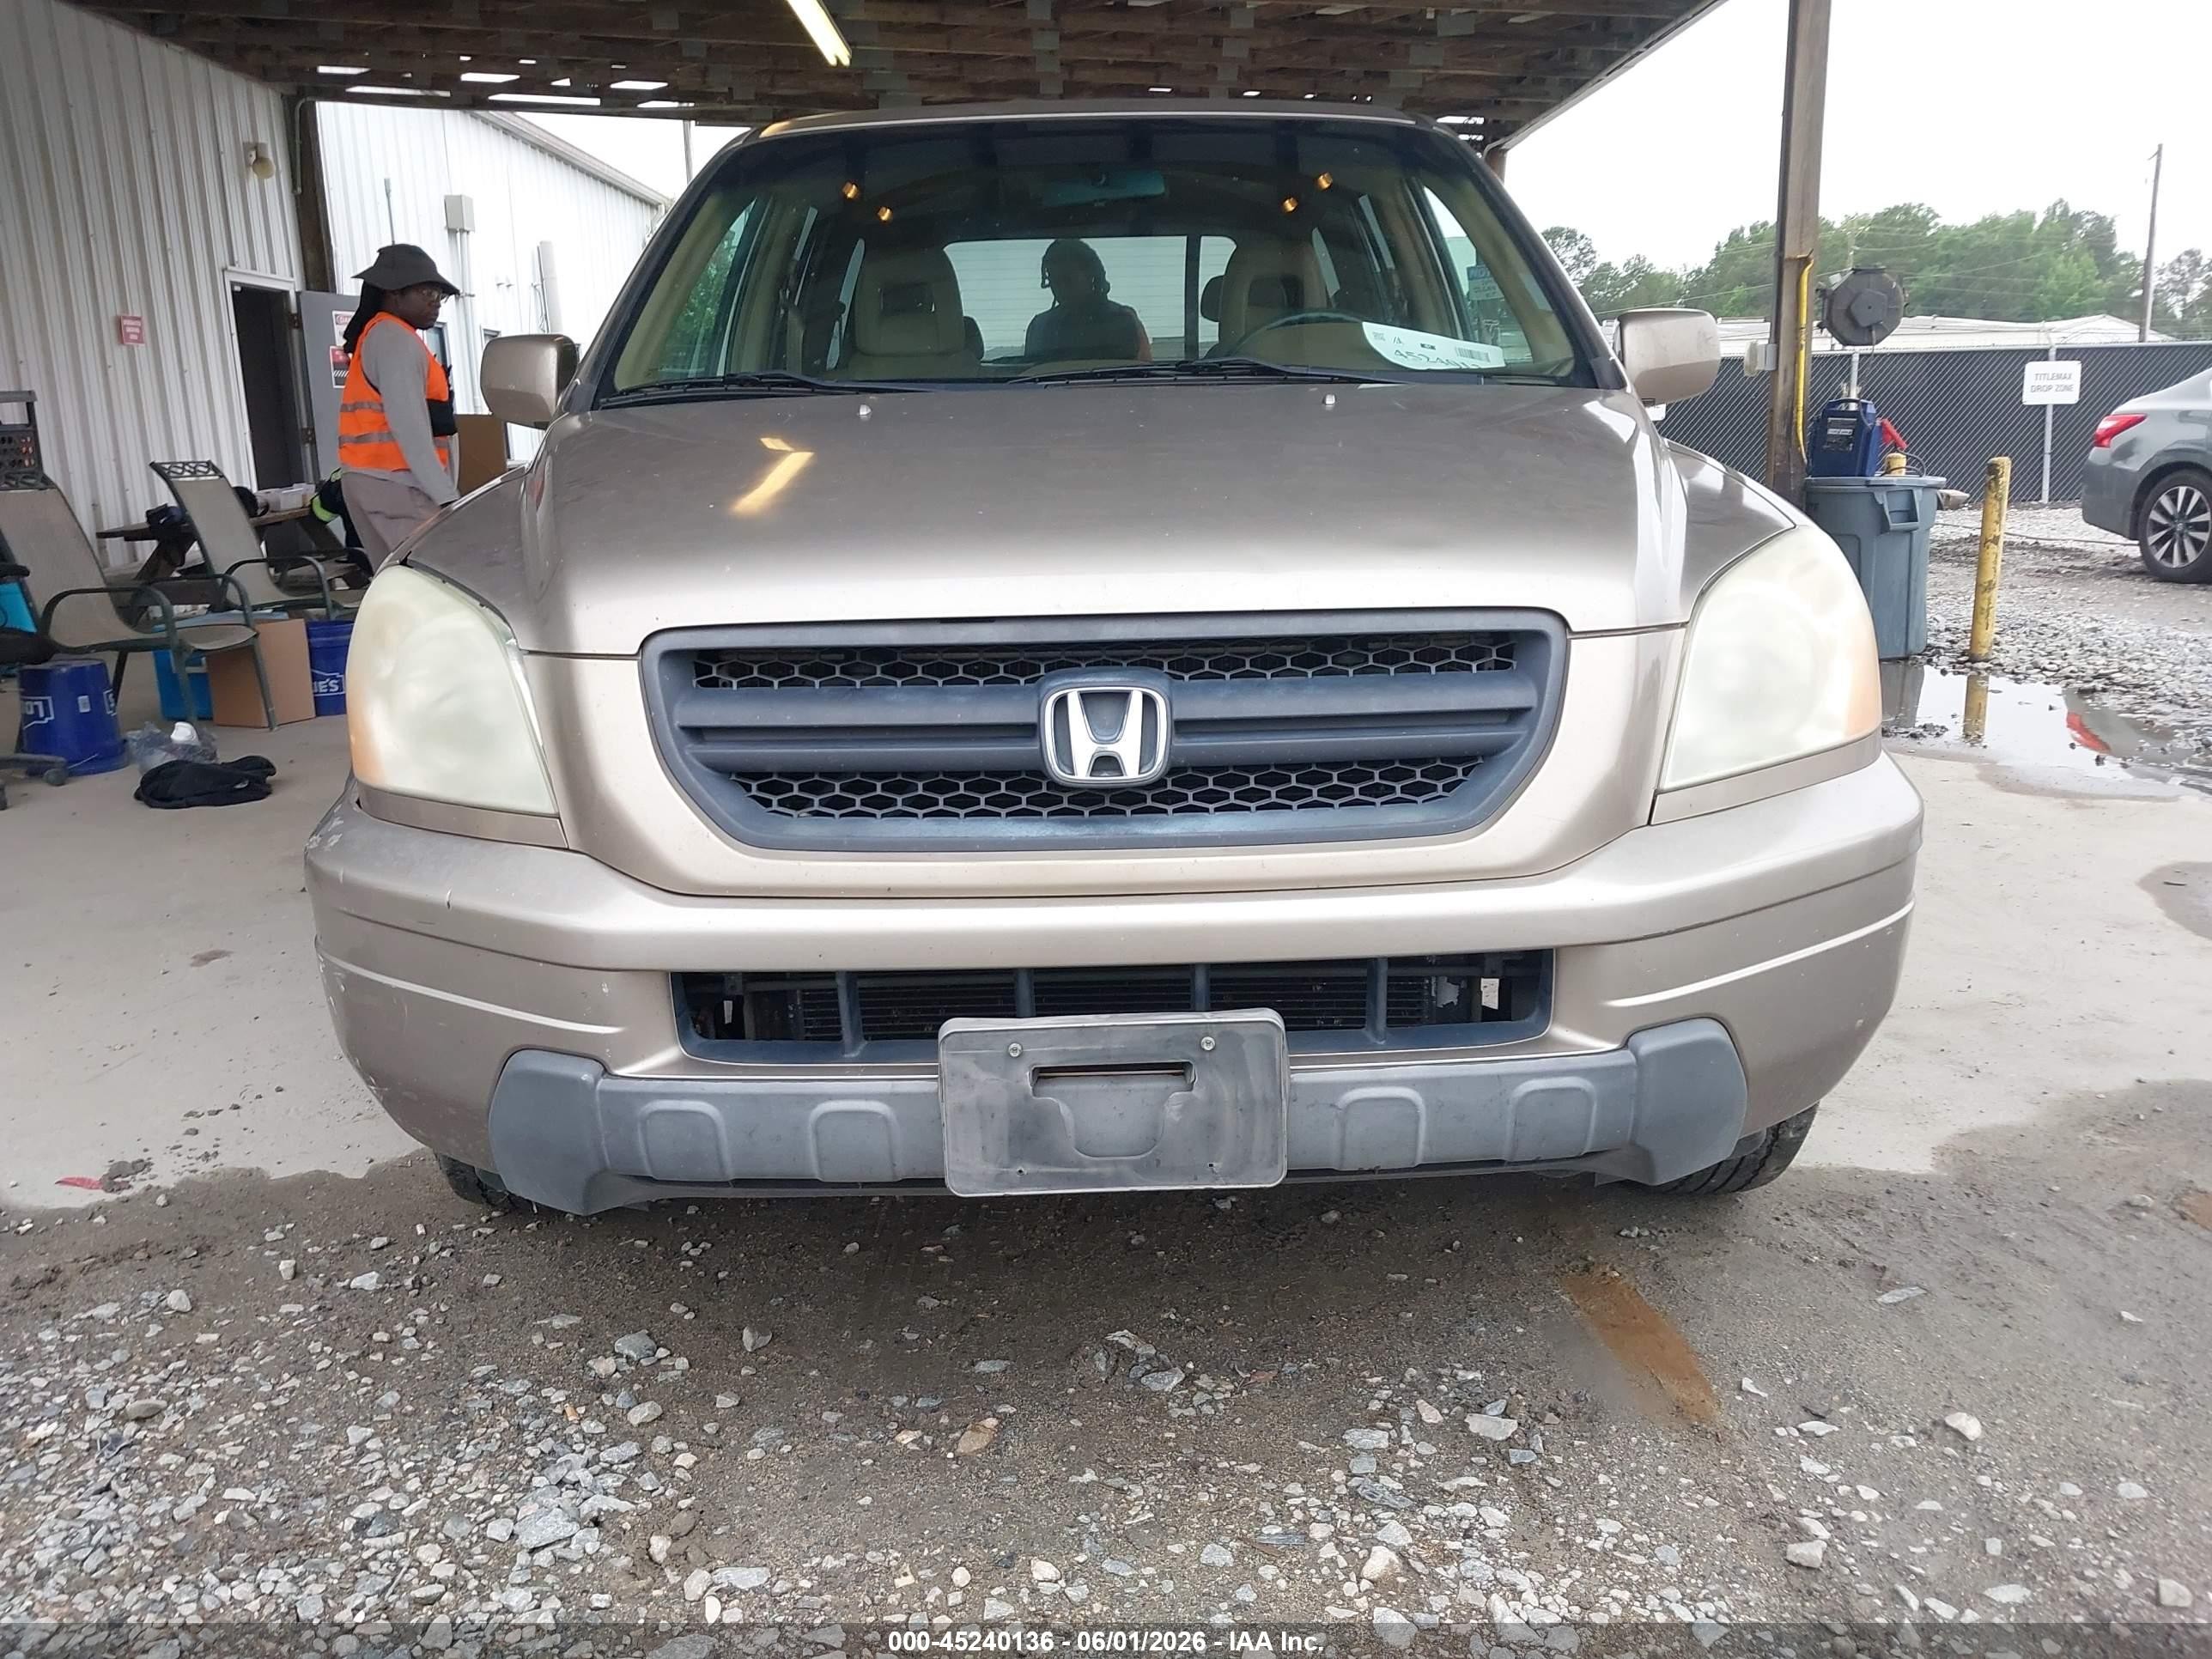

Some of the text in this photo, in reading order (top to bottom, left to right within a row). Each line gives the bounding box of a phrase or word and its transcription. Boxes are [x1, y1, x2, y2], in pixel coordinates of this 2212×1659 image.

[2034, 372, 2073, 381] TITLEMAX
[2030, 384, 2075, 392] DROP ZONE
